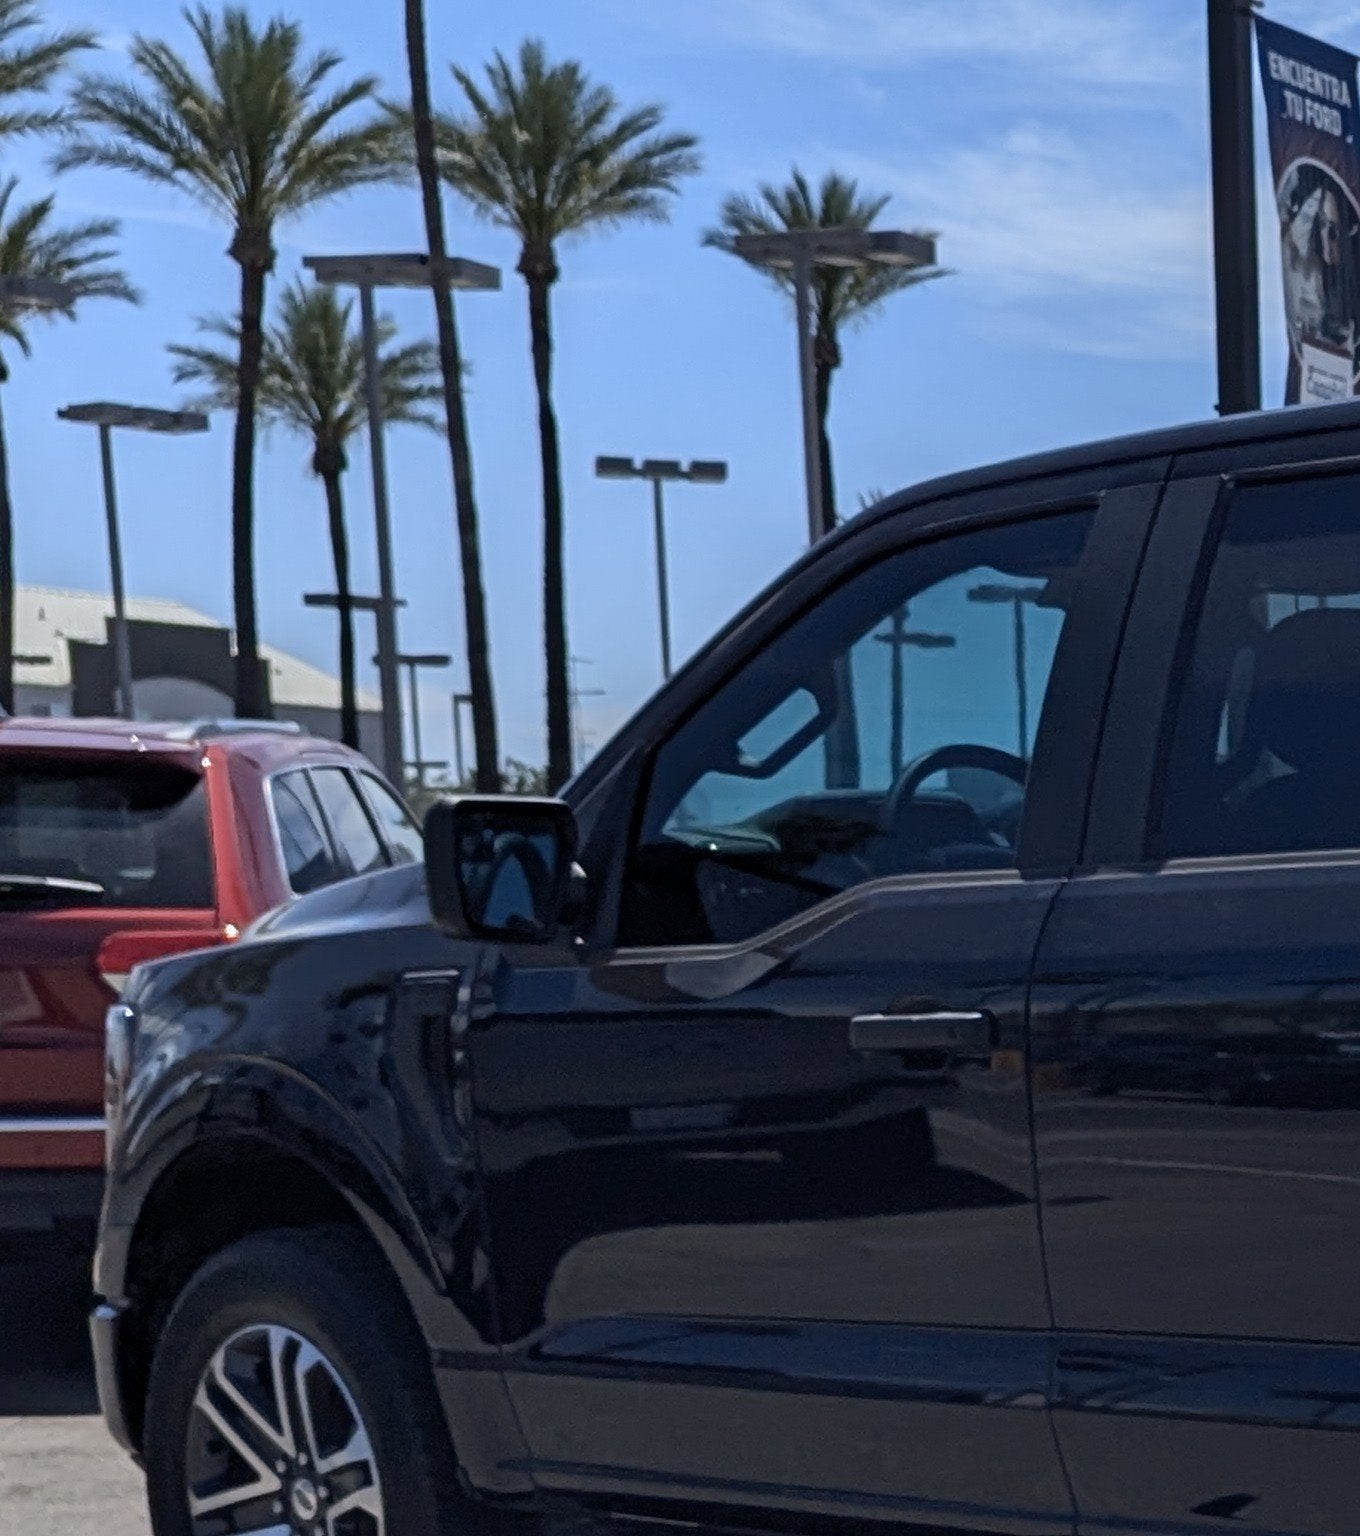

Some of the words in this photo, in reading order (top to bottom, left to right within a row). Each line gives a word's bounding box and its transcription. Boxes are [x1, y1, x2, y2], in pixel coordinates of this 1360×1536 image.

[1267, 50, 1352, 109] ENCUENTRA
[1283, 87, 1303, 121] TU
[1304, 95, 1342, 136] FORD
